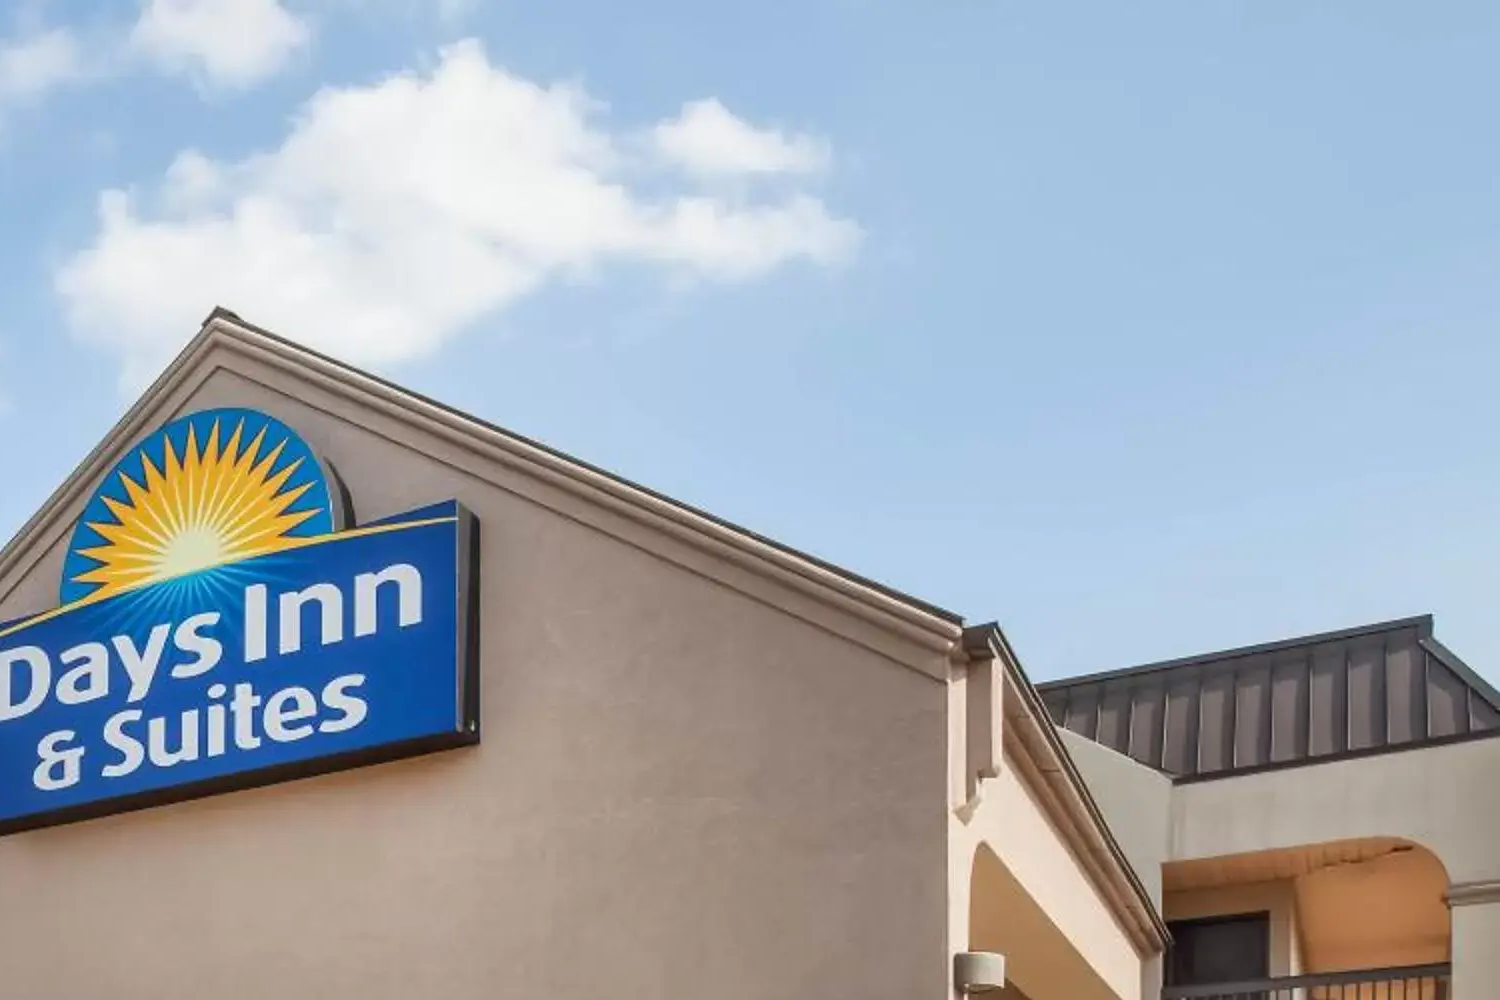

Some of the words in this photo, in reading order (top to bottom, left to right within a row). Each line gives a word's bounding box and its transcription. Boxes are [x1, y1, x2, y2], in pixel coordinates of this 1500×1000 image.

[244, 563, 422, 662] Inn
[32, 730, 85, 791] &
[102, 673, 368, 777] Suites
